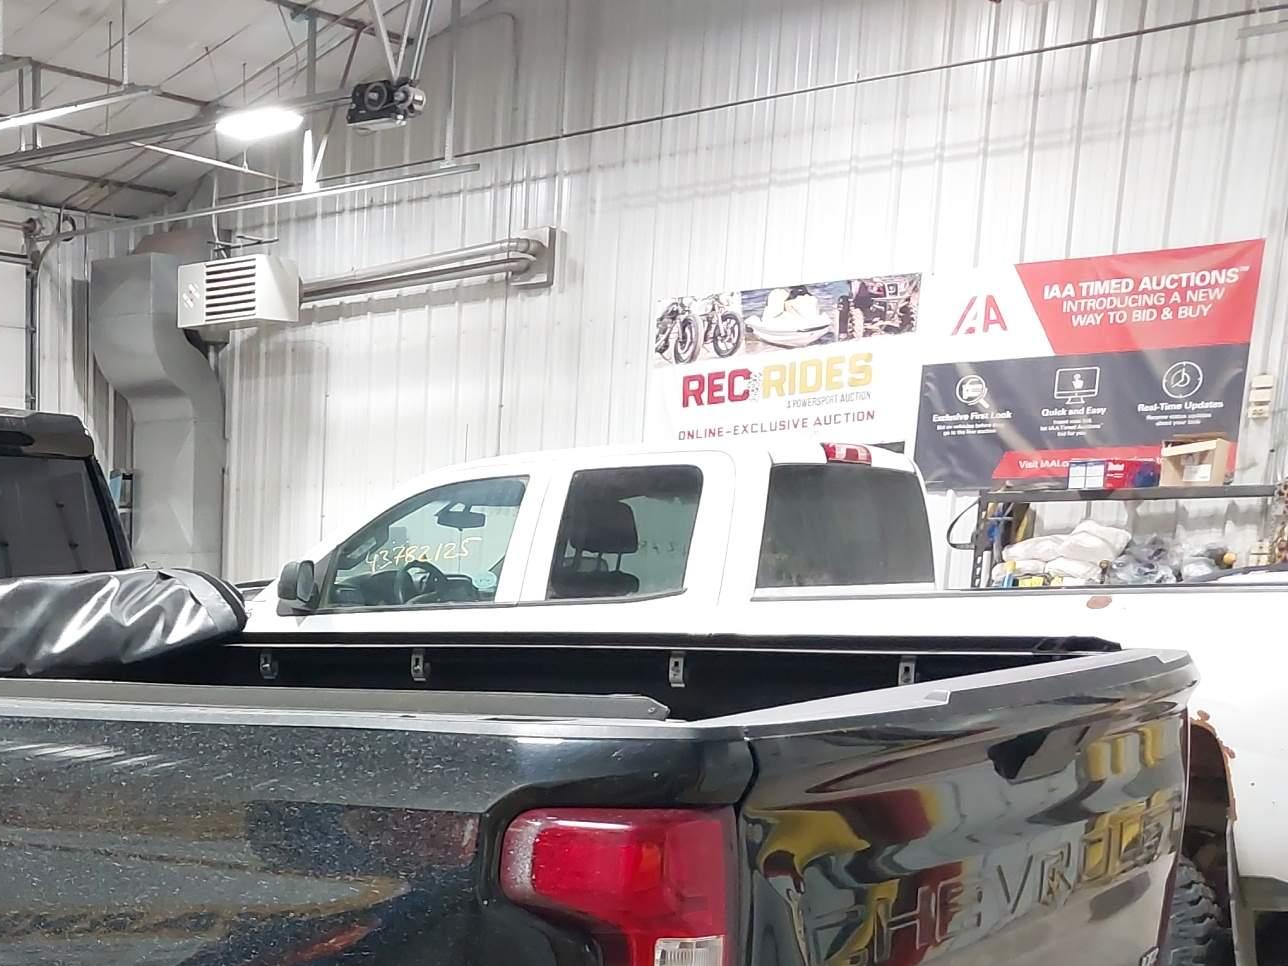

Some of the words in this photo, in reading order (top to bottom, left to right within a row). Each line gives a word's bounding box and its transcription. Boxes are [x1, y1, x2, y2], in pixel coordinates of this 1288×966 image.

[1044, 283, 1076, 300] IAA
[1078, 278, 1135, 297] TIMED
[1062, 293, 1166, 313] INTRODUCING
[1169, 291, 1182, 305] A
[1186, 287, 1226, 303] NEW
[1072, 312, 1105, 327] WAY
[1108, 310, 1128, 324] TO
[1132, 308, 1158, 322] BID
[1160, 306, 1173, 320] &
[1178, 304, 1213, 319] BUY
[682, 368, 753, 408] REC
[763, 352, 874, 399] RIDES
[792, 393, 838, 408] POWERSPORT
[840, 390, 872, 403] AUCTION
[1137, 402, 1183, 412] Real-Time
[1184, 400, 1225, 410] Updates
[932, 413, 970, 422] Exclusive
[970, 412, 989, 420] First
[991, 410, 1013, 419] Look
[1041, 407, 1067, 417] Quick
[1068, 406, 1085, 416] and
[1086, 406, 1107, 416] Easy
[678, 417, 809, 441] ONLINE-EXCLUSIVE
[812, 410, 876, 427] AUCTION
[1018, 460, 1039, 469] Visit
[365, 536, 483, 576] 43782125
